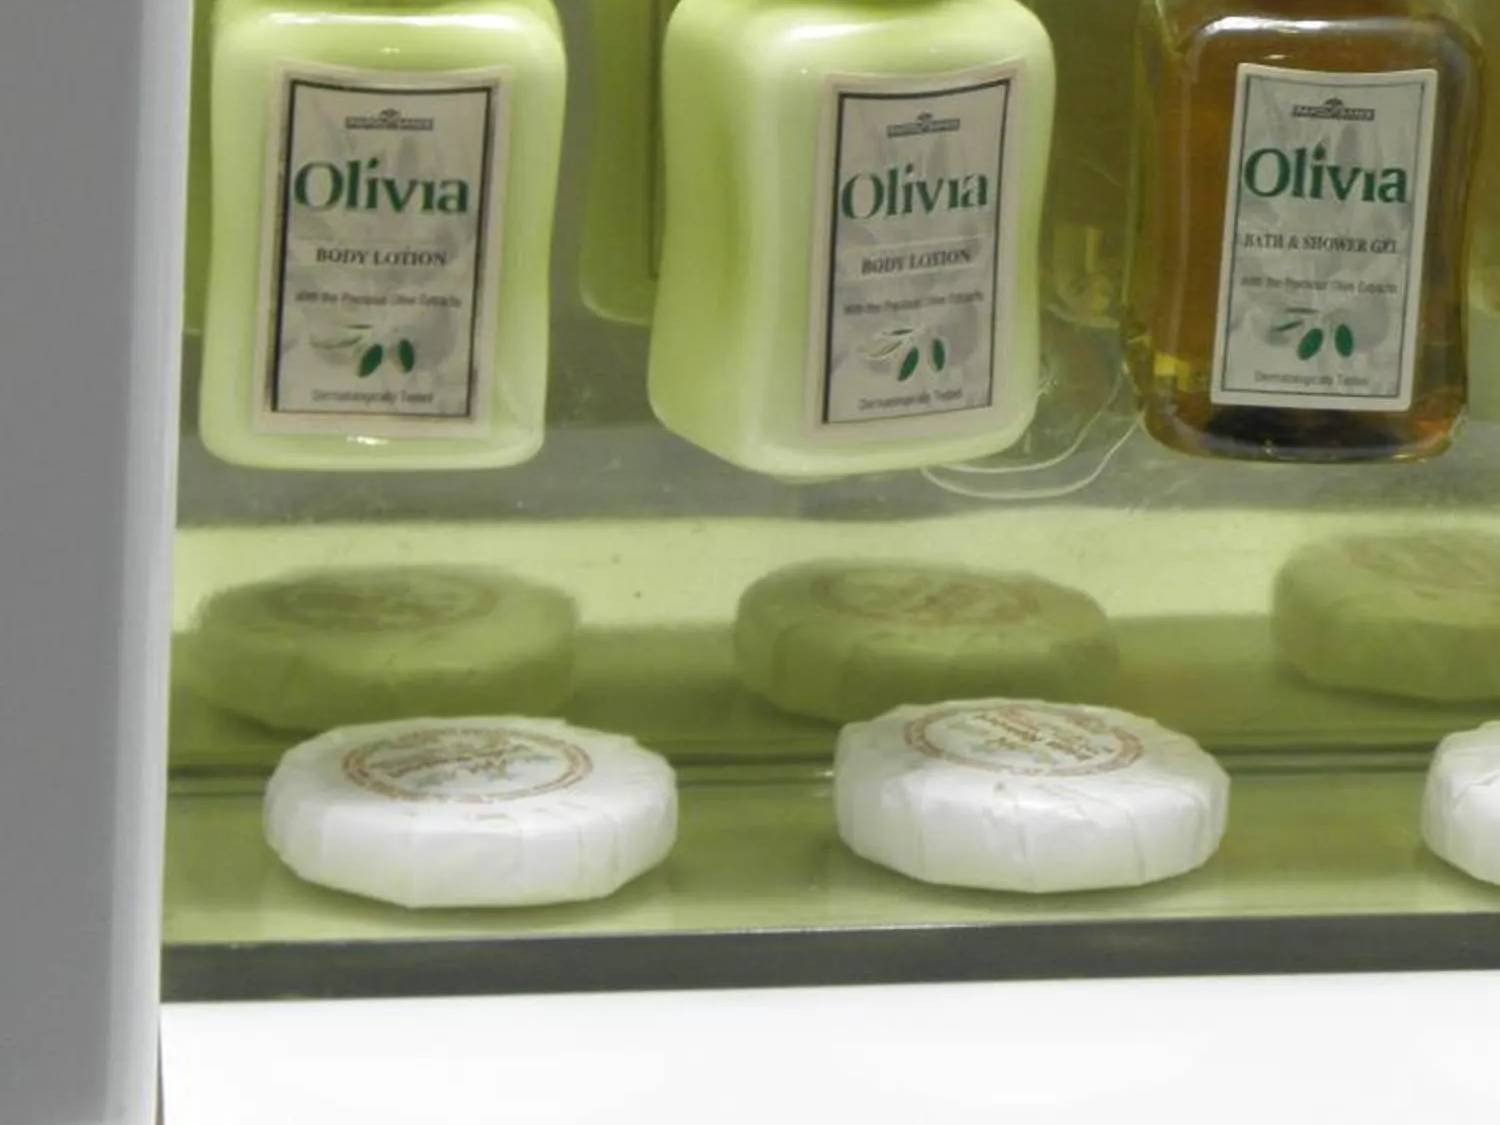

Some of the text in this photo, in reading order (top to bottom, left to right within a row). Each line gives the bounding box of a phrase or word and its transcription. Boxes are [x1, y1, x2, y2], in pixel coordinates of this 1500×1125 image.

[295, 157, 469, 214] Olivia
[841, 164, 988, 219] Olivia
[1244, 142, 1407, 203] Olivia
[316, 247, 447, 267] BODY LOTION
[861, 249, 971, 275] BODY LOTION
[1244, 233, 1398, 254] BATH & SHOWER GEL
